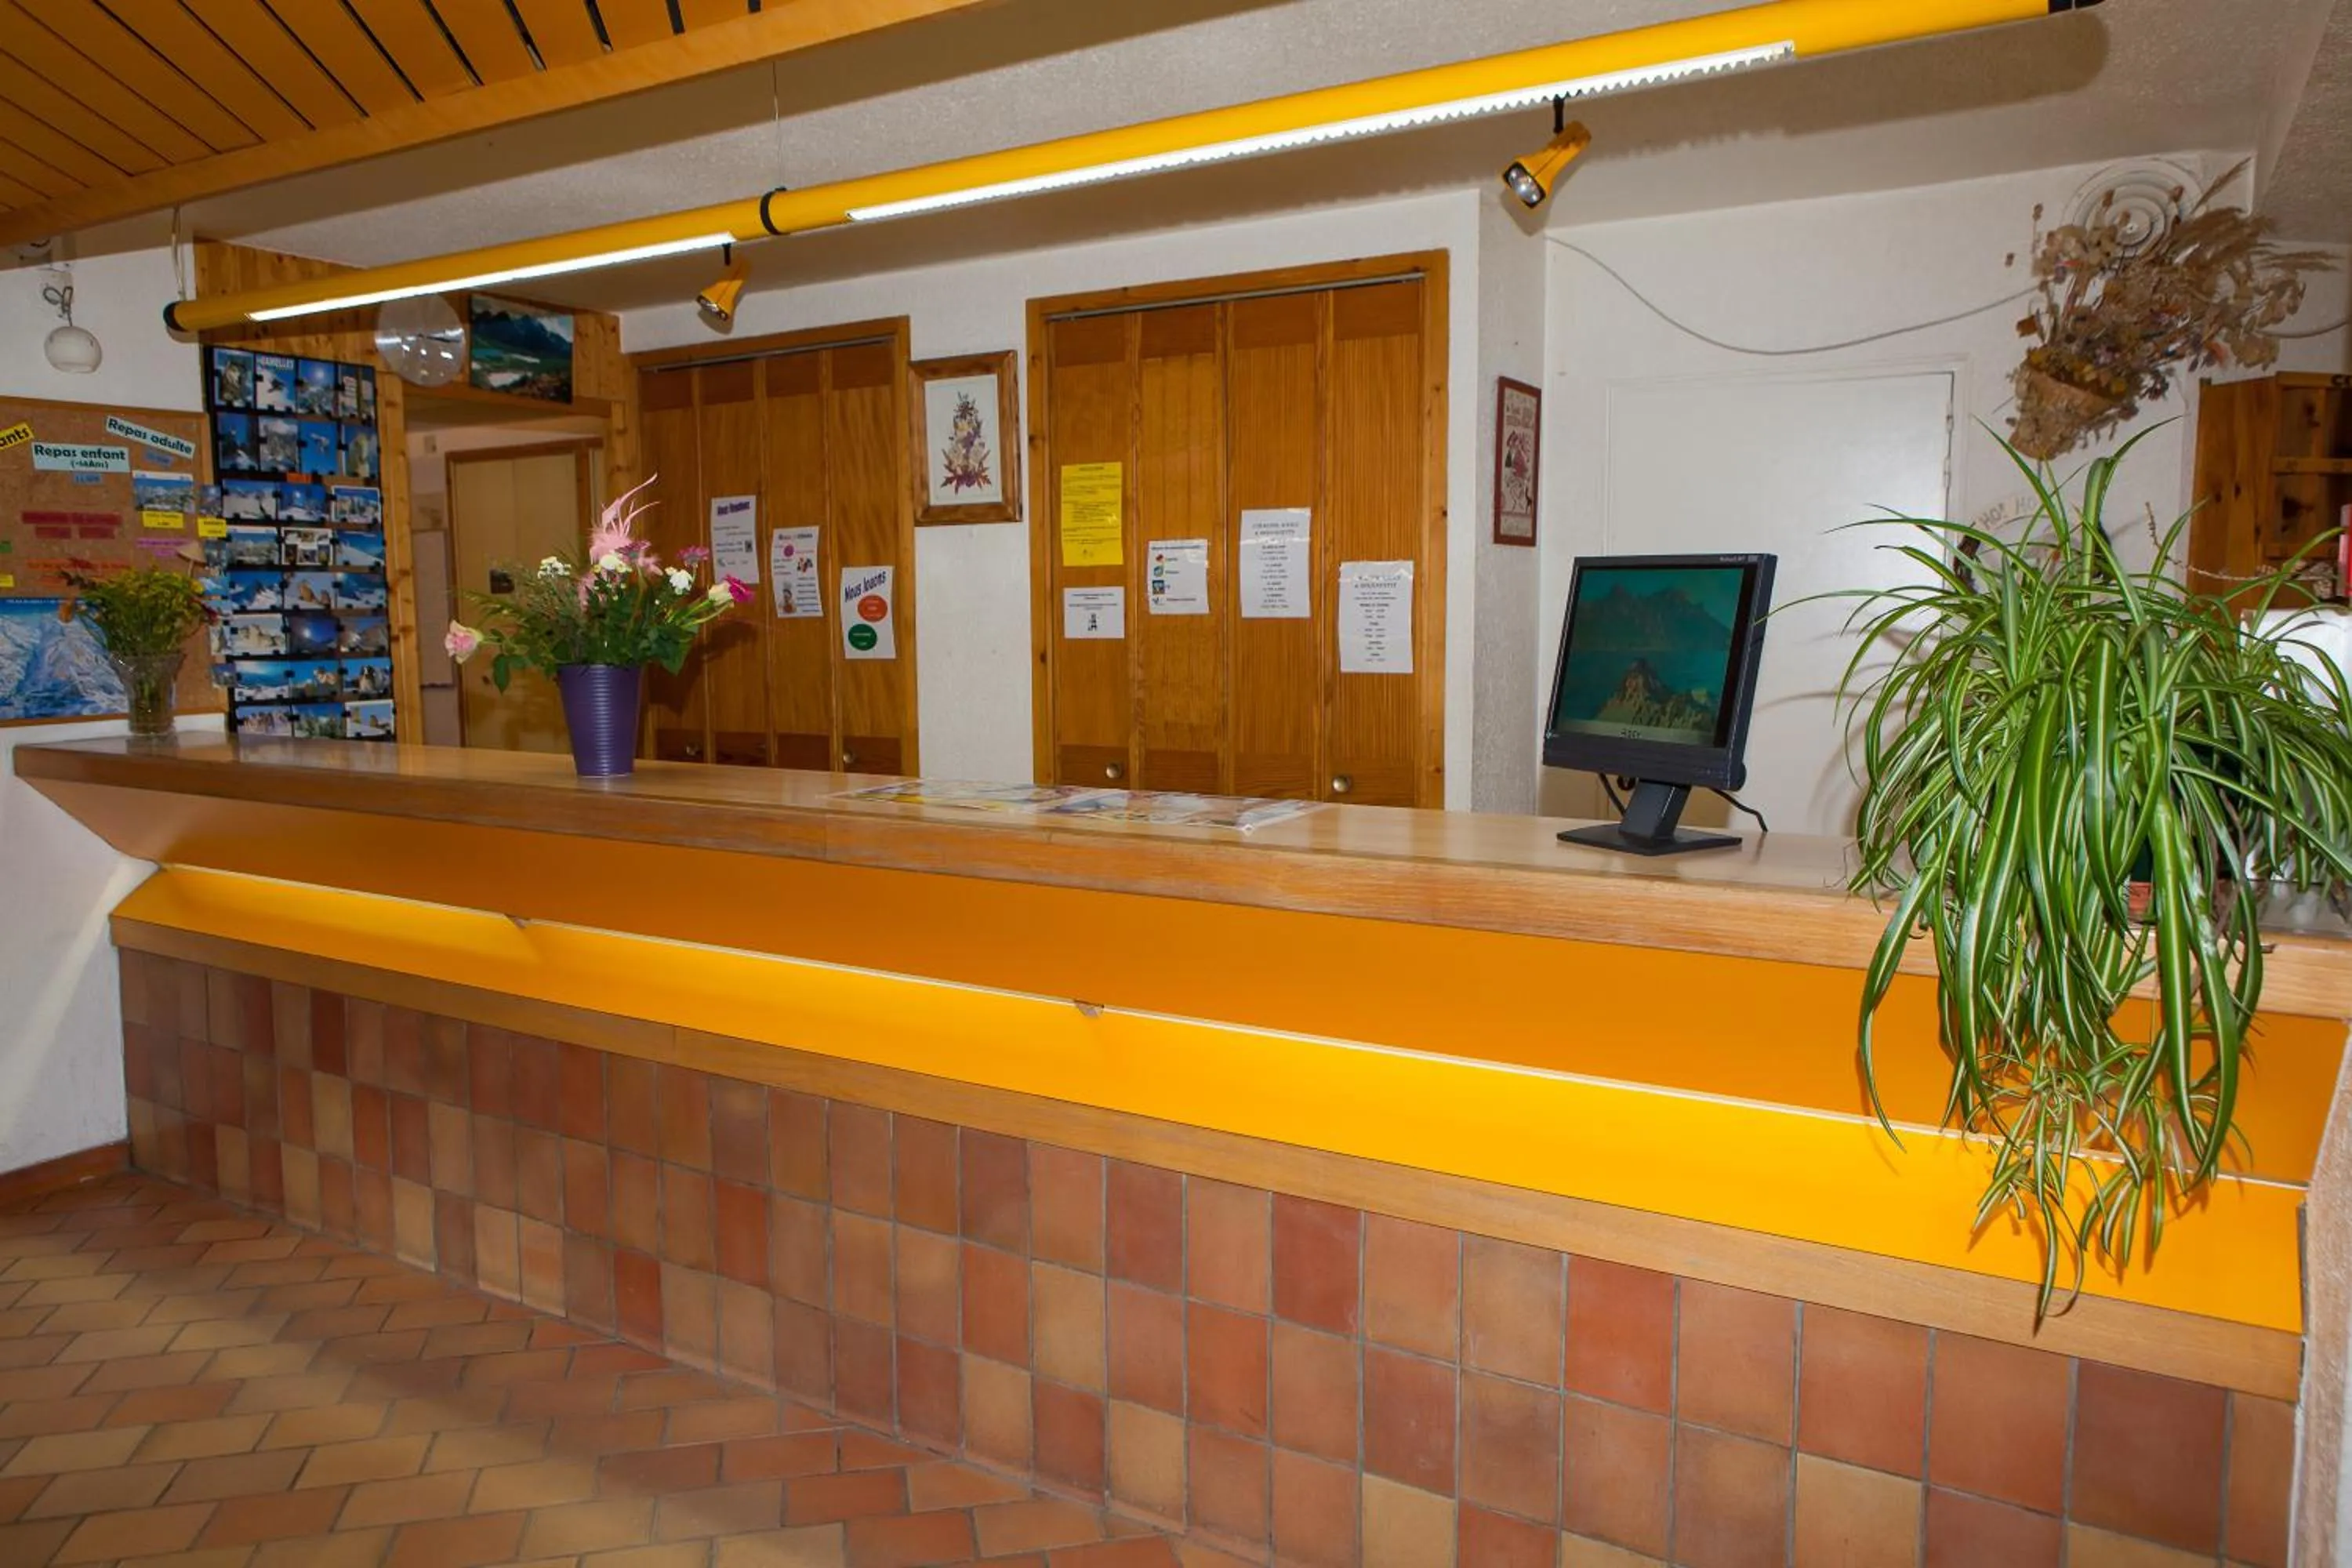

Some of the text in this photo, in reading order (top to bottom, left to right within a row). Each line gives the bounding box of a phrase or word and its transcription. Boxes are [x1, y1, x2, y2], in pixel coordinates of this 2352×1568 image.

[108, 418, 193, 455] Repas adulte
[34, 445, 125, 460] Repas enfant
